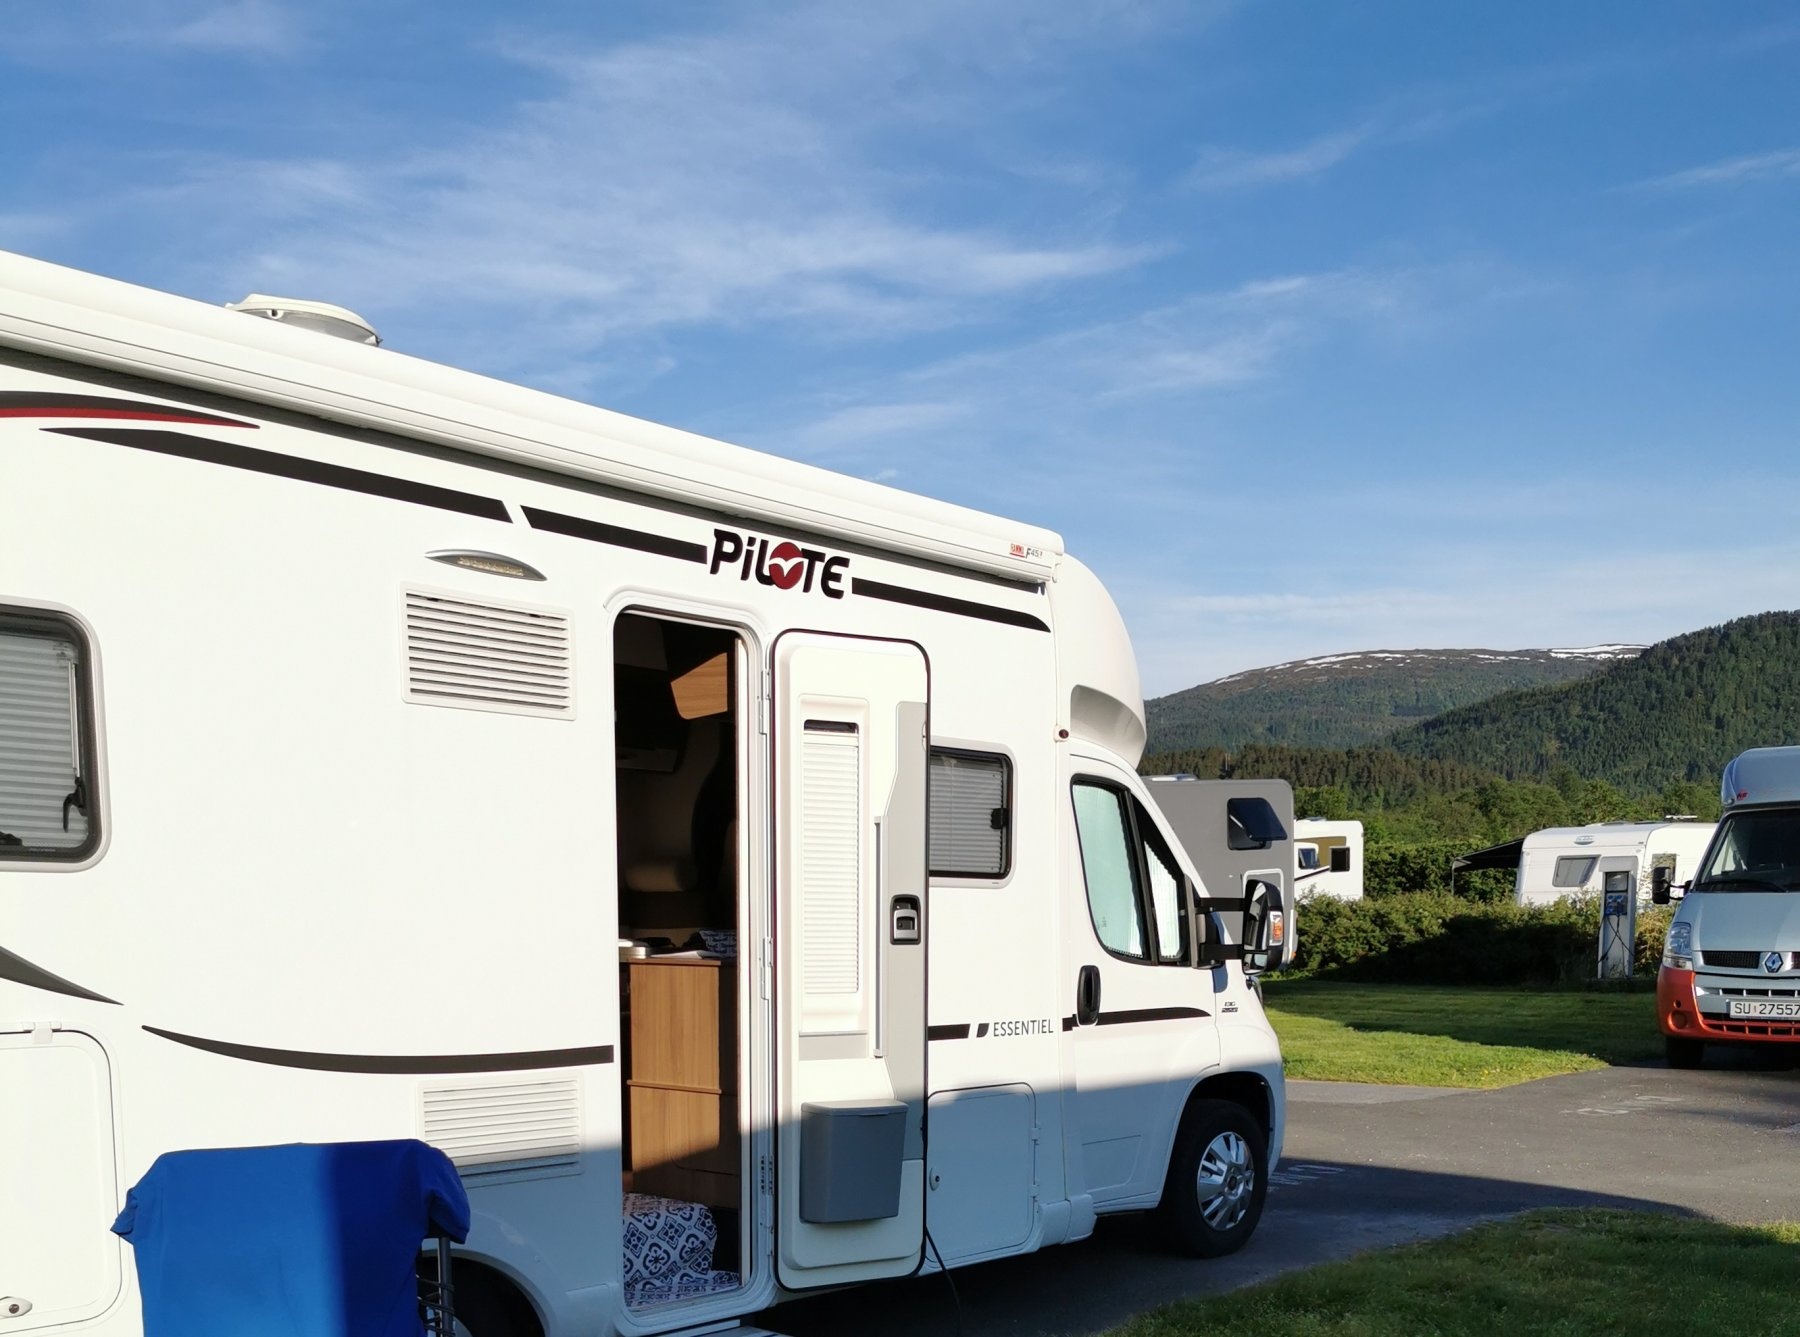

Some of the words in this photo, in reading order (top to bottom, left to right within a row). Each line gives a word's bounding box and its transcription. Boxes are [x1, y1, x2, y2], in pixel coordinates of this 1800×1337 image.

[1734, 1002, 1751, 1015] SU
[1758, 1003, 1800, 1016] 27557
[993, 1018, 1054, 1037] ESSENTIEL
